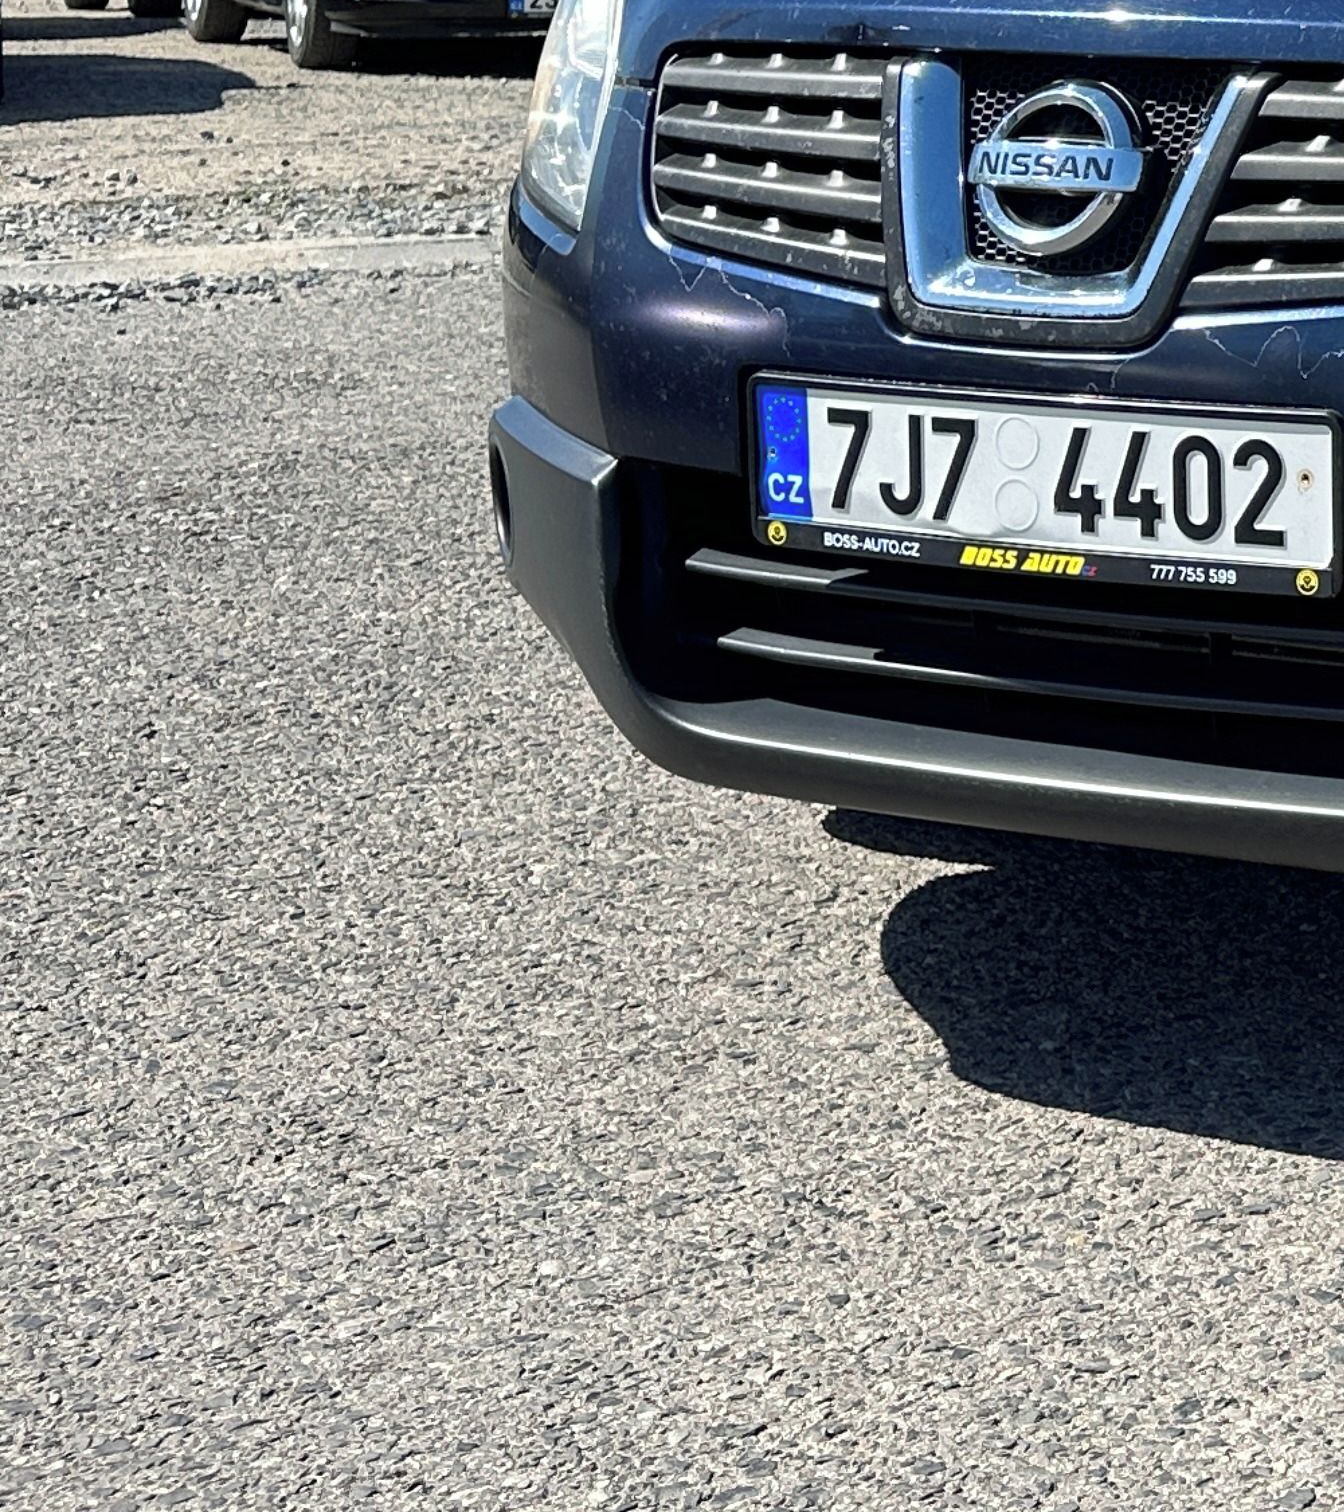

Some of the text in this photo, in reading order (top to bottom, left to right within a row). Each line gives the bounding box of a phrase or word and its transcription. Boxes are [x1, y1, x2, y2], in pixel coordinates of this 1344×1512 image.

[978, 151, 1114, 181] NISSAN
[768, 406, 1288, 548] CZ 7J7 4402
[823, 531, 921, 558] BOSS-AUTO.CZ
[959, 545, 1018, 571] BOSS
[1021, 552, 1085, 576] AUTO
[1150, 564, 1175, 581] 777
[1178, 566, 1206, 583] 755
[1208, 568, 1237, 586] 599
